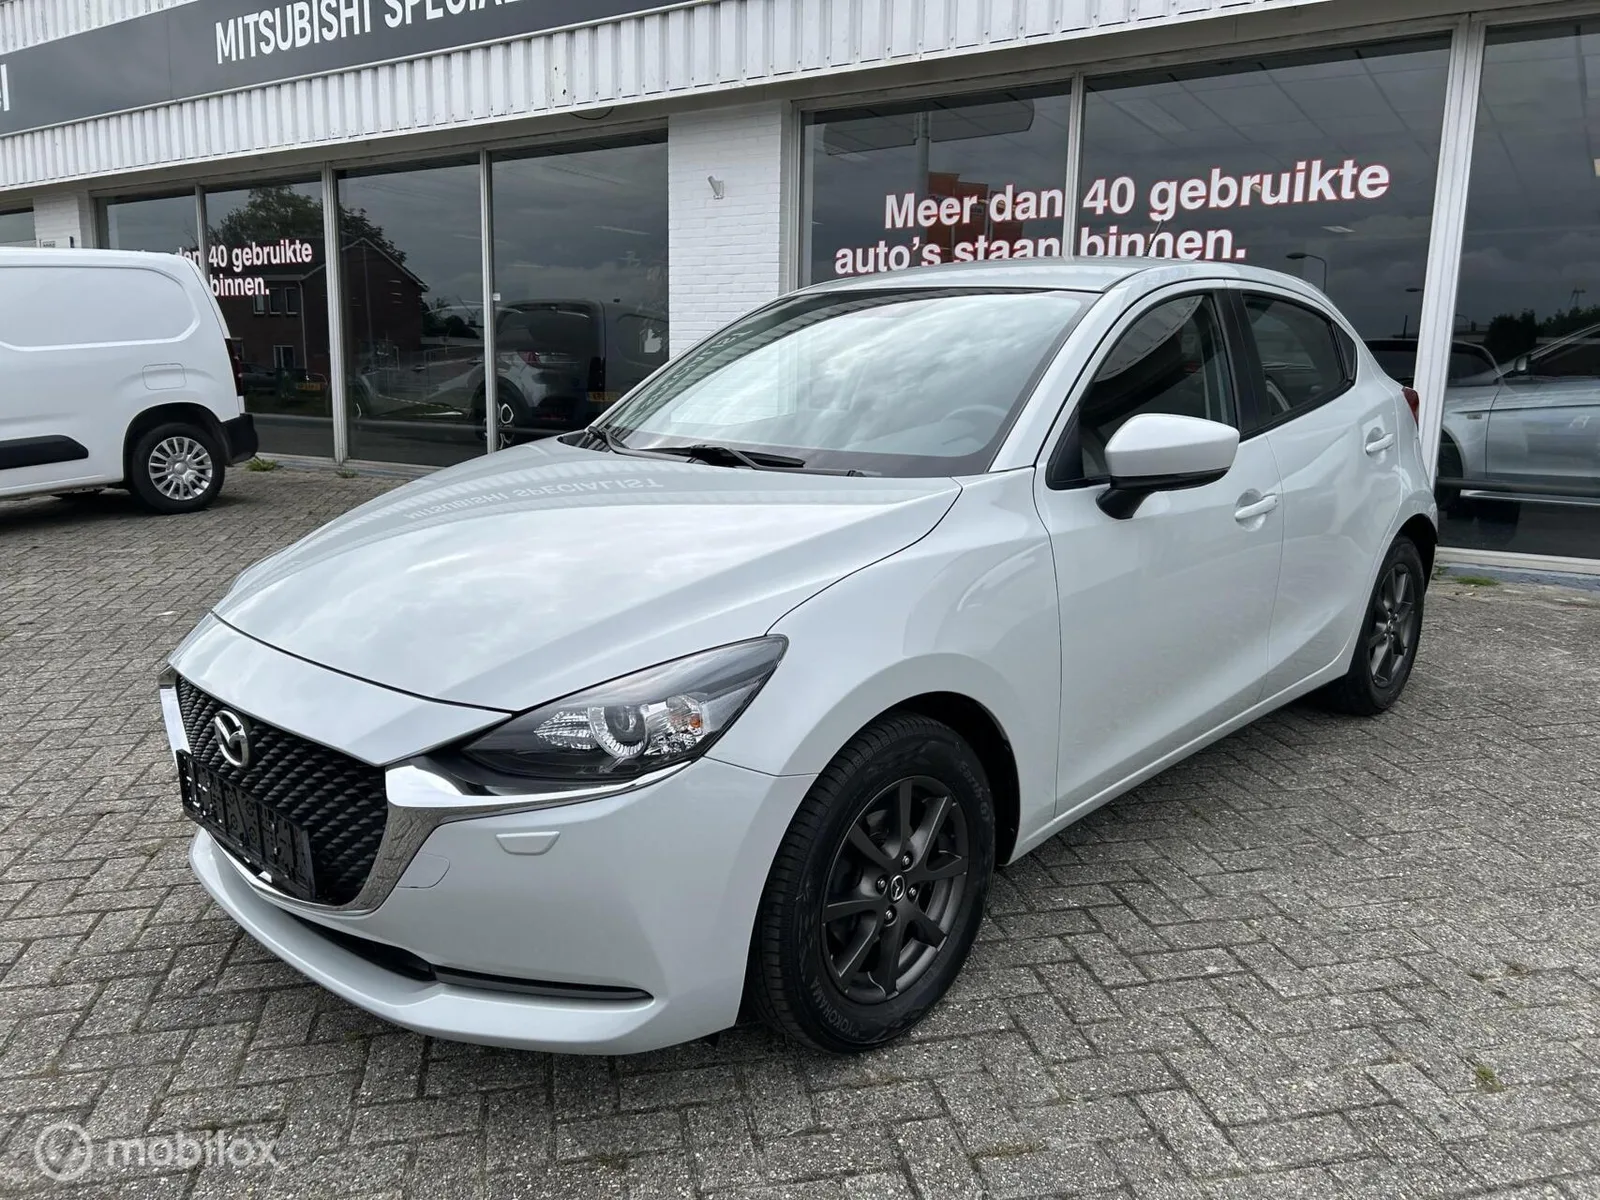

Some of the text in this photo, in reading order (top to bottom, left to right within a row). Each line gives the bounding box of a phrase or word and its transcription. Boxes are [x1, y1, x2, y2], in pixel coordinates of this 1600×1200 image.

[215, 0, 371, 64] MITSUBISHI
[885, 159, 1390, 230] Meer dan 40 gebruikte
[208, 244, 228, 268] 40
[232, 239, 313, 273] gebruikte
[834, 226, 1247, 275] auto's staan binnen.
[209, 274, 270, 297] binnen.
